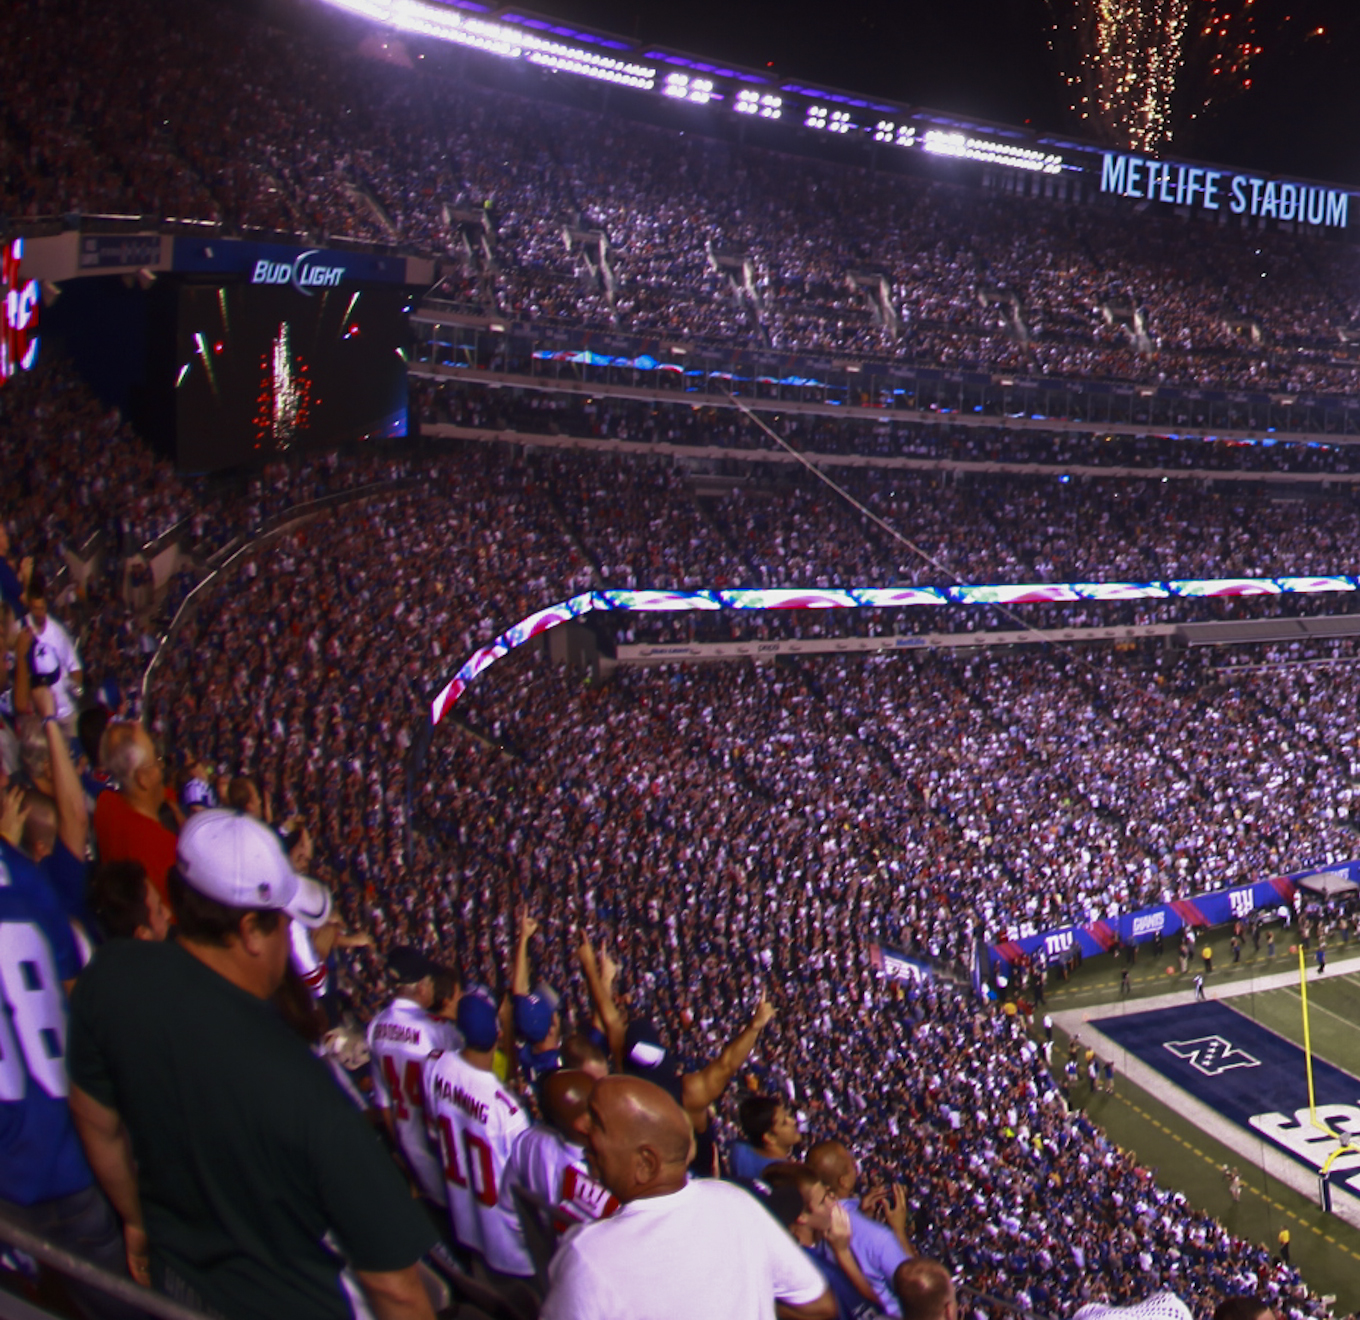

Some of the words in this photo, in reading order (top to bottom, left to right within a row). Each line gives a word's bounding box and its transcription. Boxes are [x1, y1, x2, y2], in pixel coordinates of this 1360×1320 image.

[1101, 153, 1221, 210] METLIFE
[1229, 176, 1349, 228] STADIUM
[251, 260, 292, 284] BUD
[300, 263, 346, 286] LIGHT
[1133, 912, 1165, 936] GIANTS
[434, 1073, 489, 1124] MANNING
[436, 1113, 498, 1208] 10
